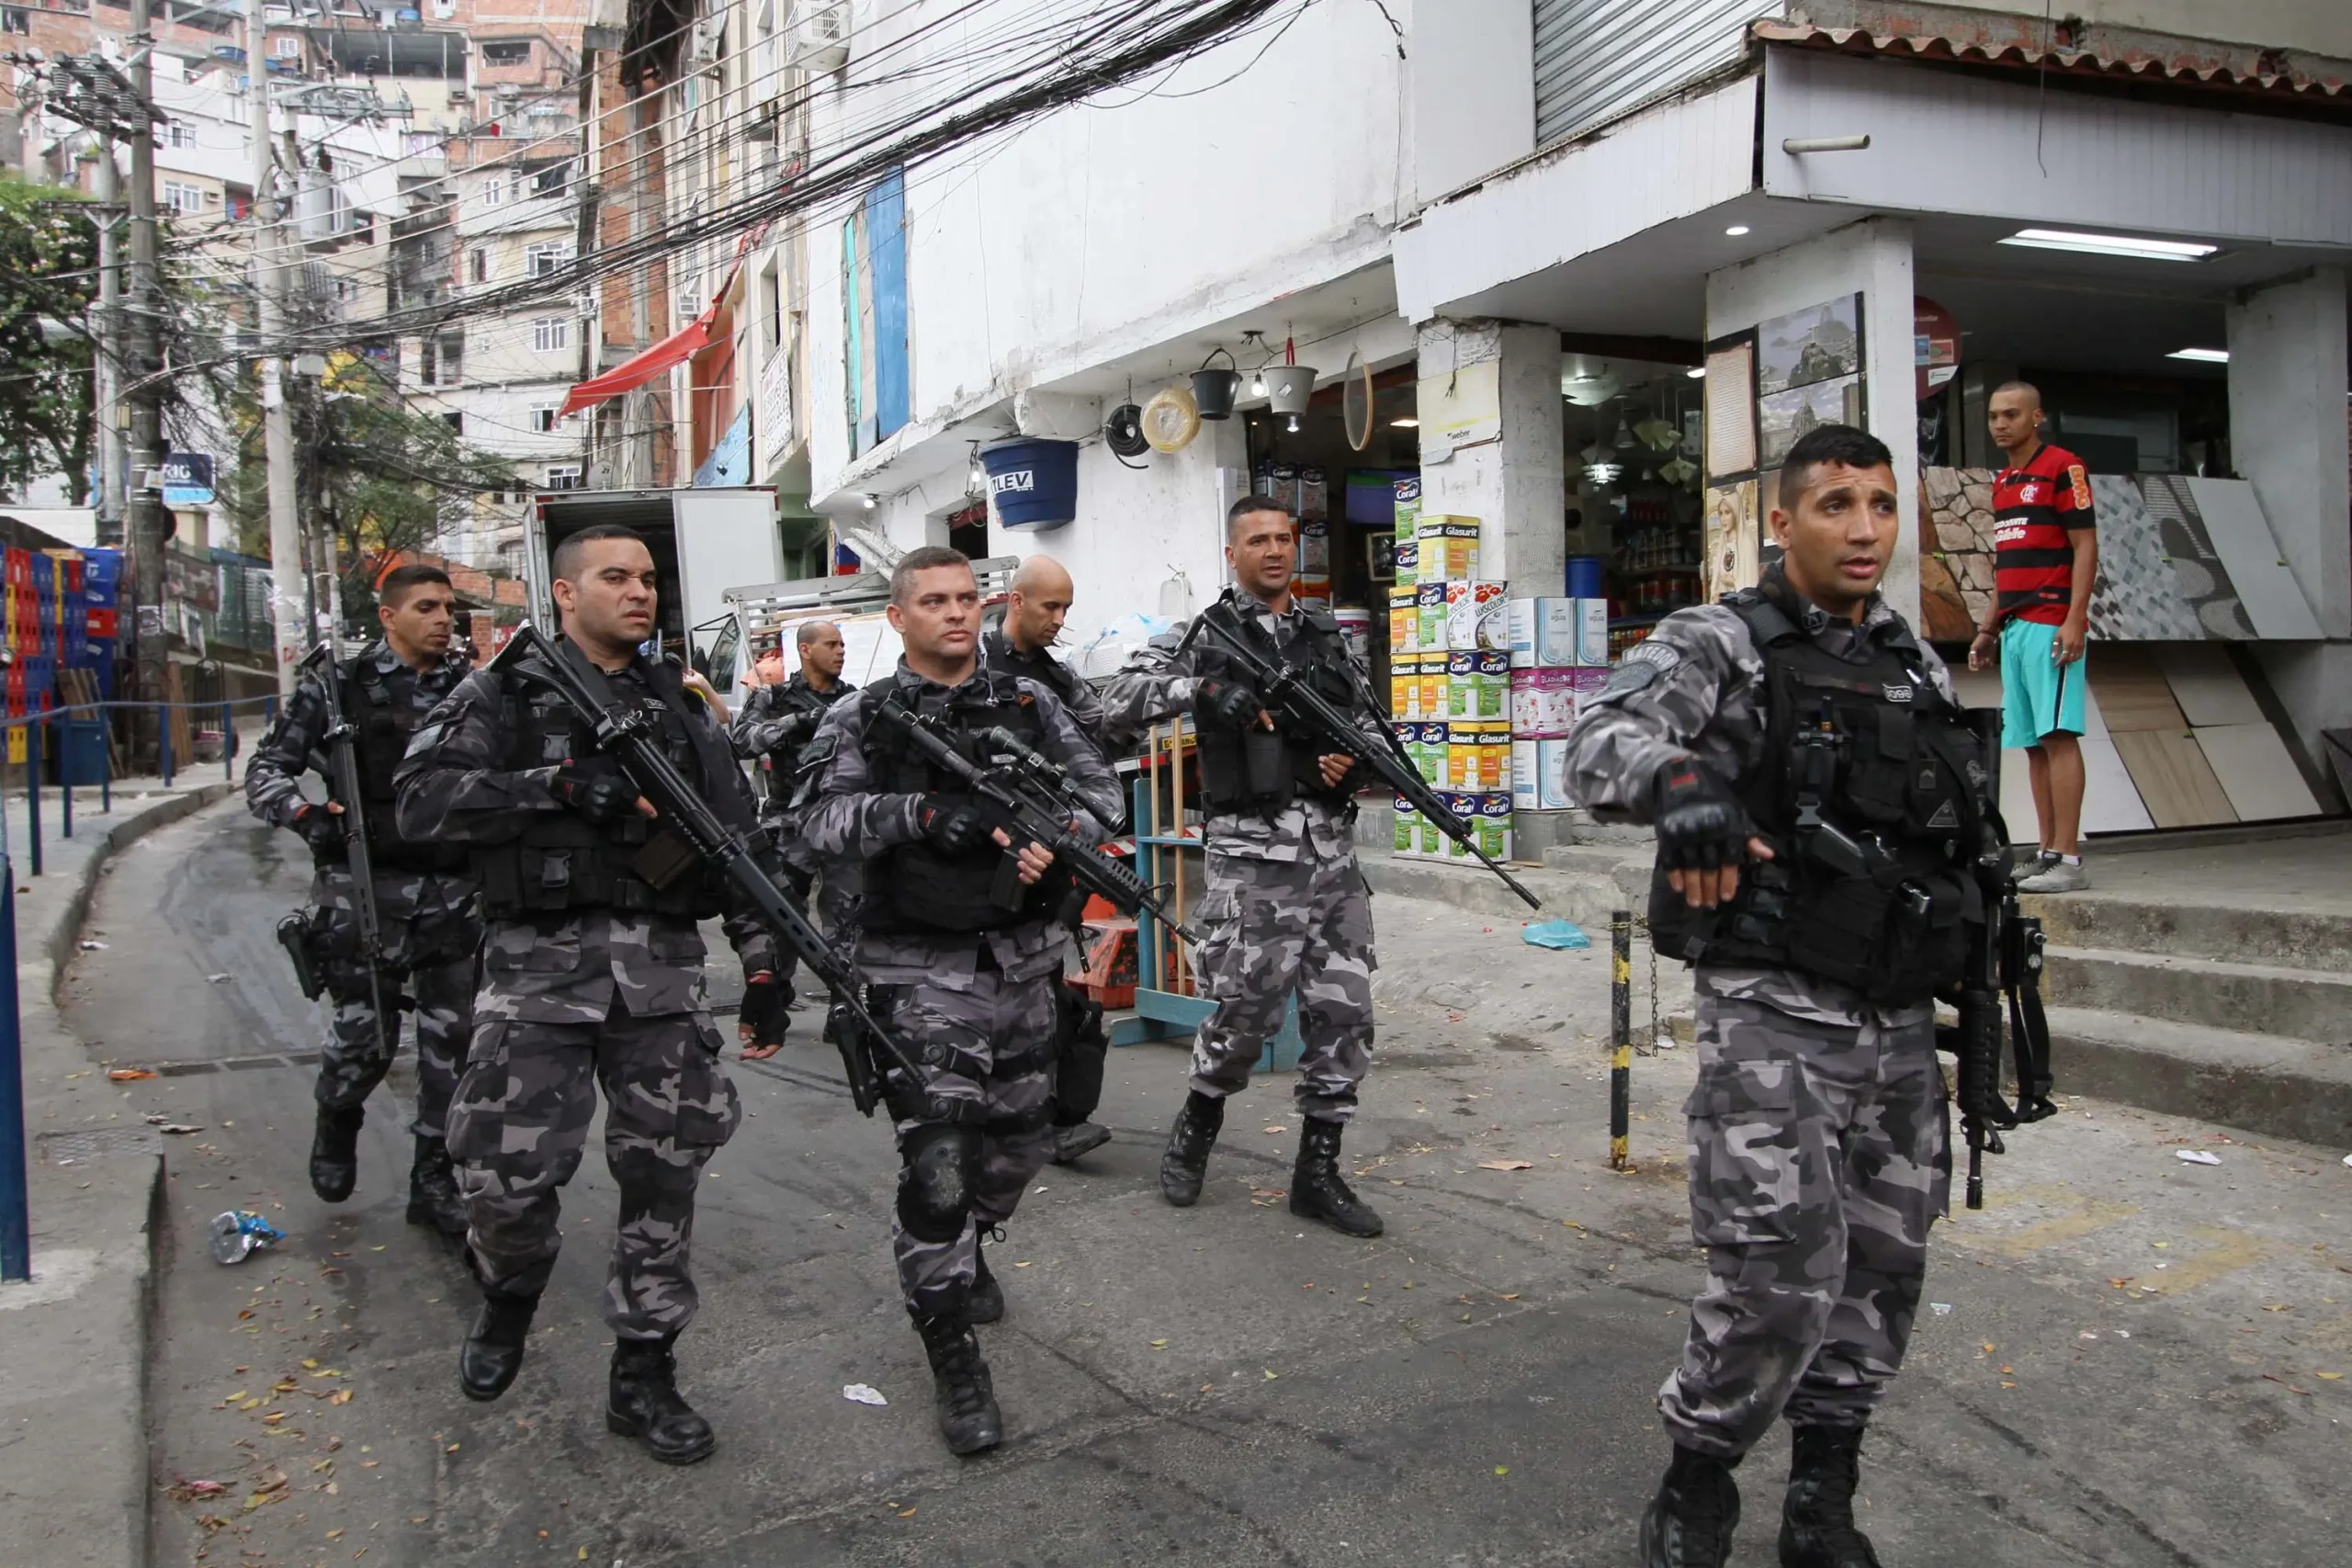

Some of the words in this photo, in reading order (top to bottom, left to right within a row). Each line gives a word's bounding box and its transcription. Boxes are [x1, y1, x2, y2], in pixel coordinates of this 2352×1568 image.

[1452, 430, 1470, 439] weber
[1396, 489, 1416, 499] Coral
[1419, 526, 1442, 537] Glasurit
[1446, 526, 1477, 537] Glasurit
[1397, 555, 1417, 564] Coral
[1390, 597, 1414, 607] Glasurit
[1419, 595, 1438, 604] Coral
[1391, 664, 1416, 674] Glasurit
[1420, 663, 1445, 673] Glasurit
[1450, 662, 1470, 671] Coral
[1480, 661, 1504, 671] Coral
[1421, 732, 1440, 742] Coral
[1449, 734, 1475, 744] Glasurit
[1479, 734, 1510, 743] Glasurit
[1396, 798, 1413, 808] Cora
[1453, 804, 1472, 814] Coral
[1483, 804, 1507, 814] Coral
